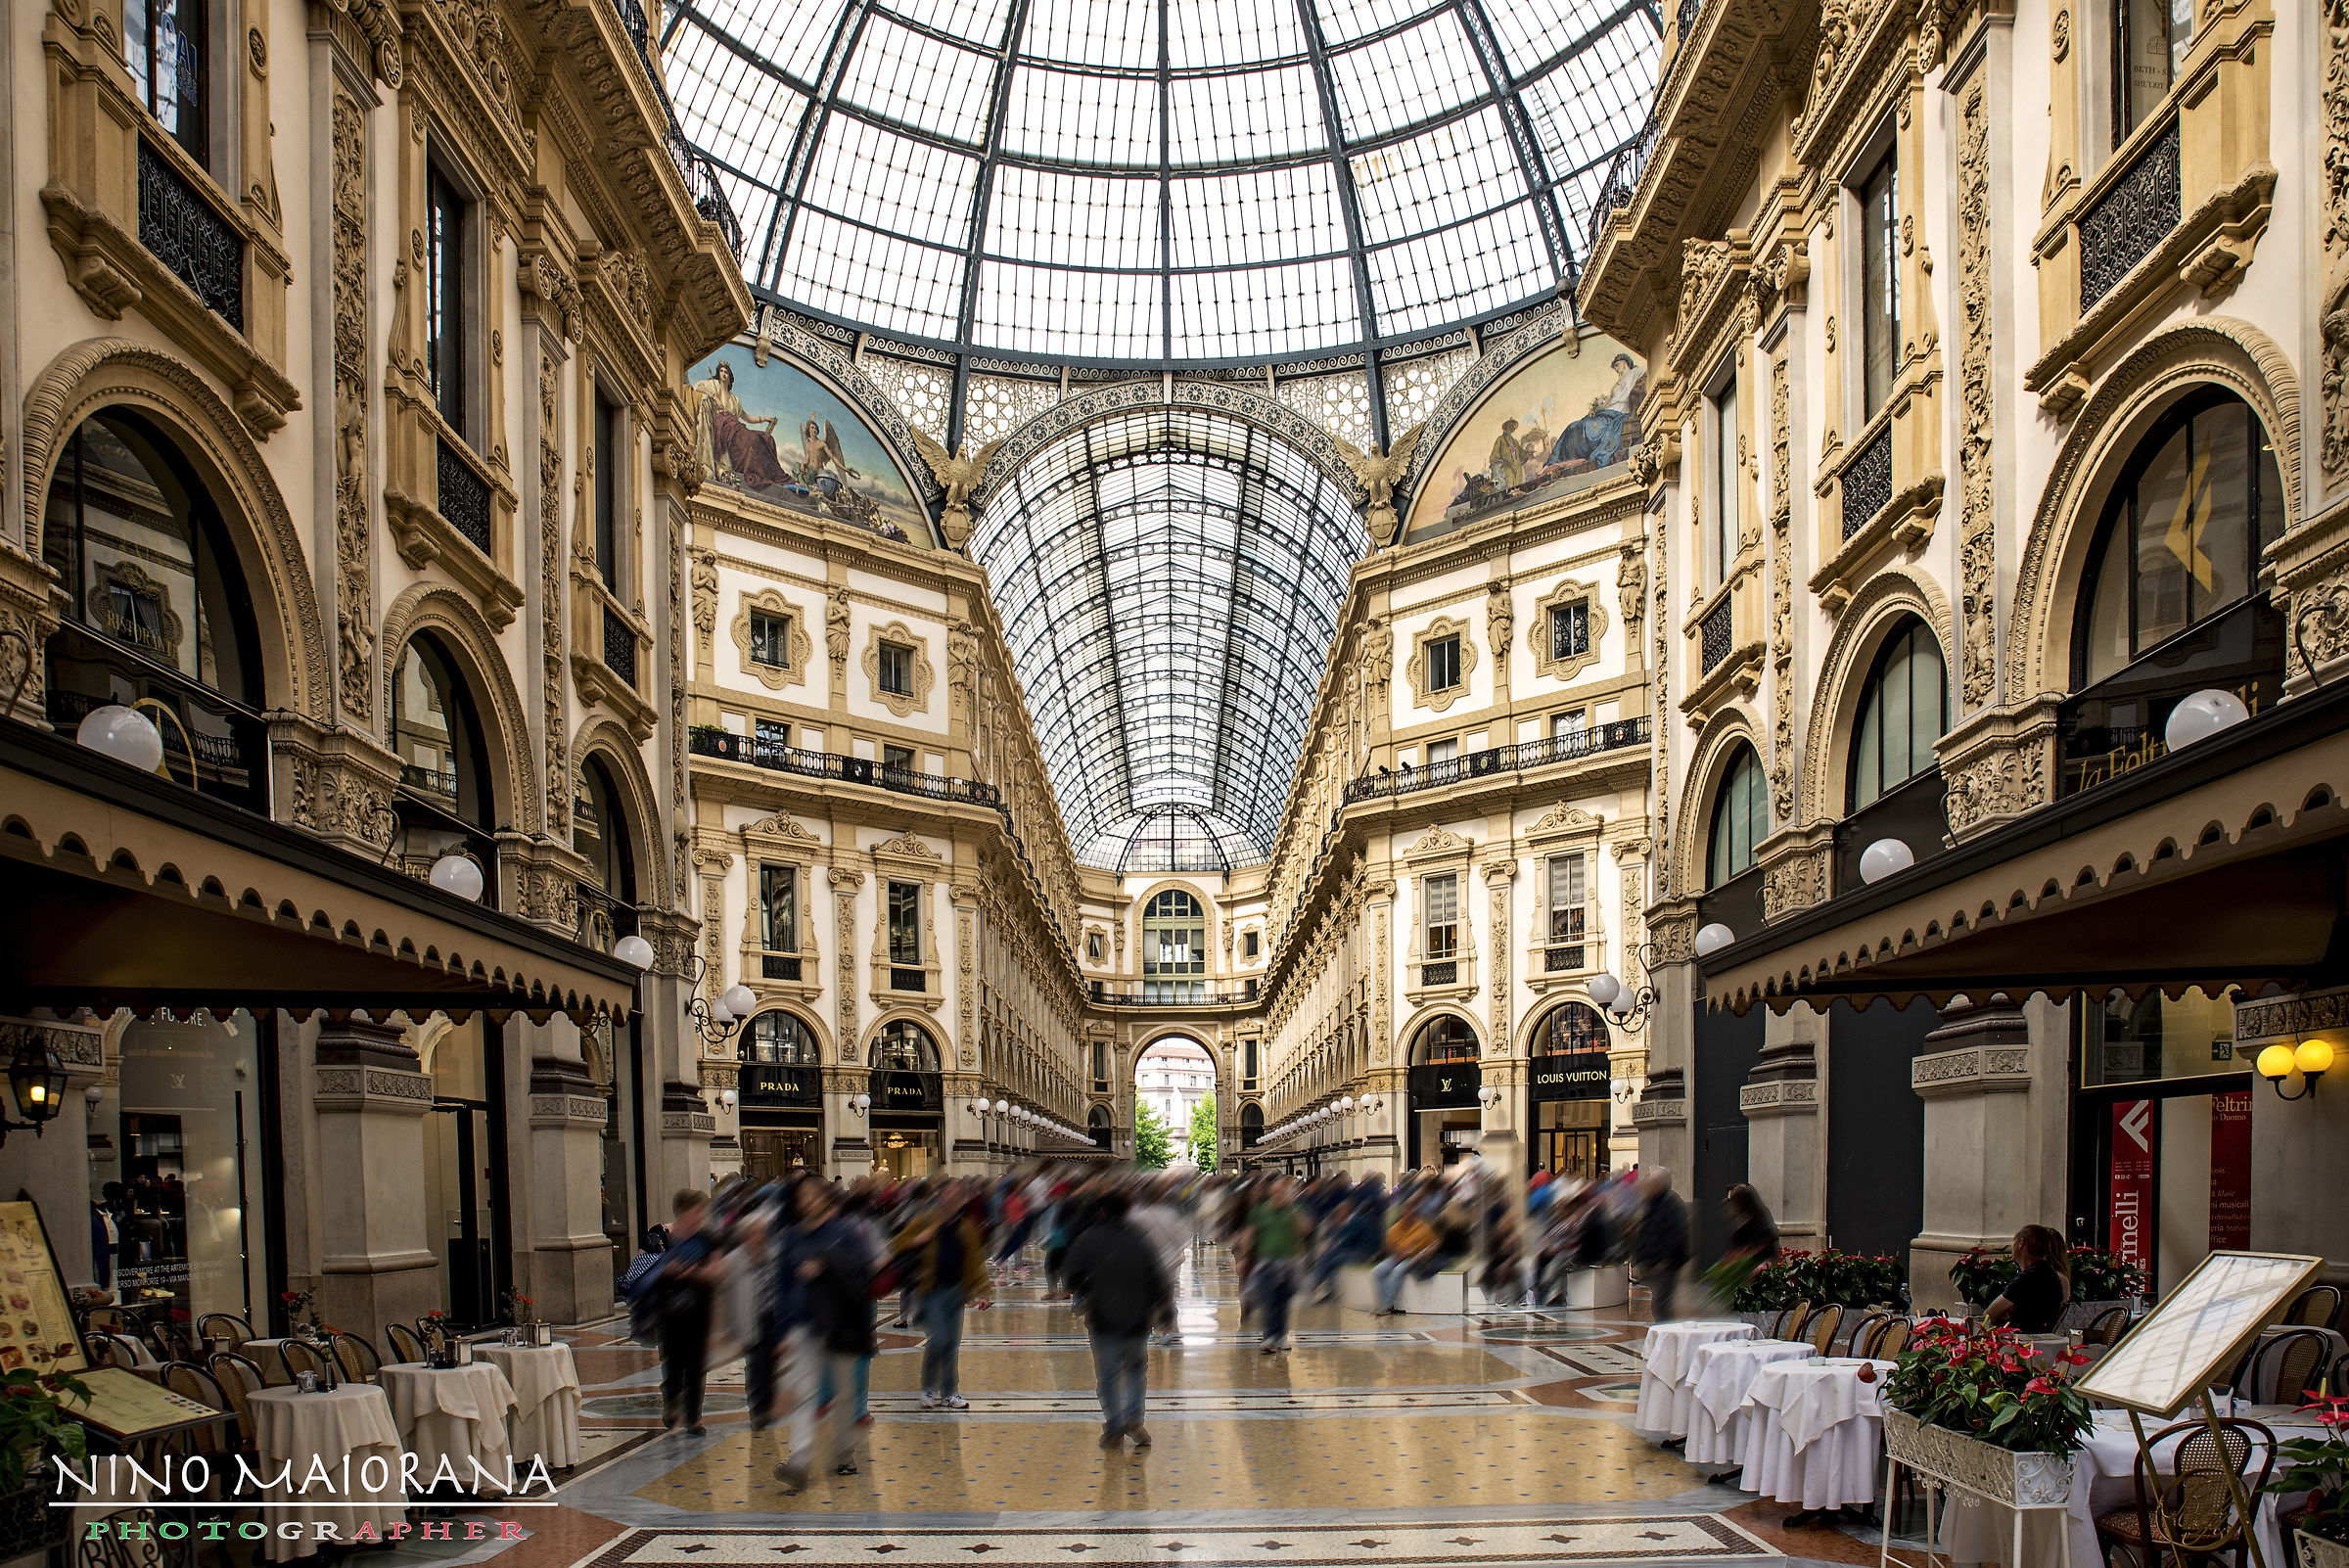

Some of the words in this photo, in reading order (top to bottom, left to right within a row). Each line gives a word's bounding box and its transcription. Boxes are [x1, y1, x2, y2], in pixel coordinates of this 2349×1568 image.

[2134, 65, 2155, 74] BETH
[1537, 1073, 1565, 1084] LOUIS
[1565, 1069, 1608, 1083] VUITTON
[760, 1082, 800, 1091] PRADA
[887, 1086, 923, 1095] PRADA
[2219, 1199, 2249, 1209] musicali
